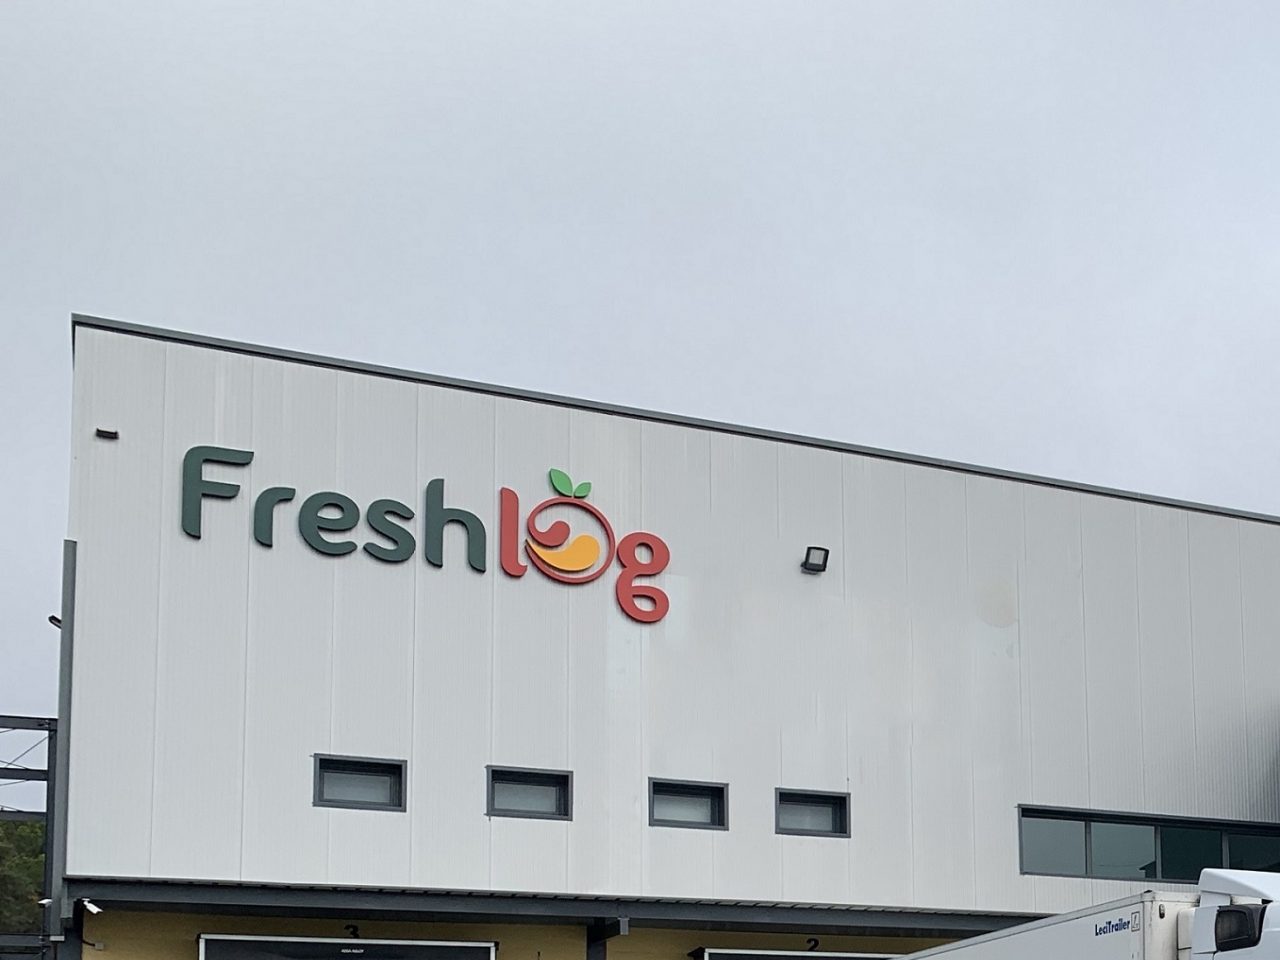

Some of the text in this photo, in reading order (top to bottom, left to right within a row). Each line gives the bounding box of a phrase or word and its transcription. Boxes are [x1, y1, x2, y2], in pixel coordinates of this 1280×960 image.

[181, 445, 671, 623] Freshlog
[344, 925, 359, 939] 3
[807, 938, 819, 952] 2
